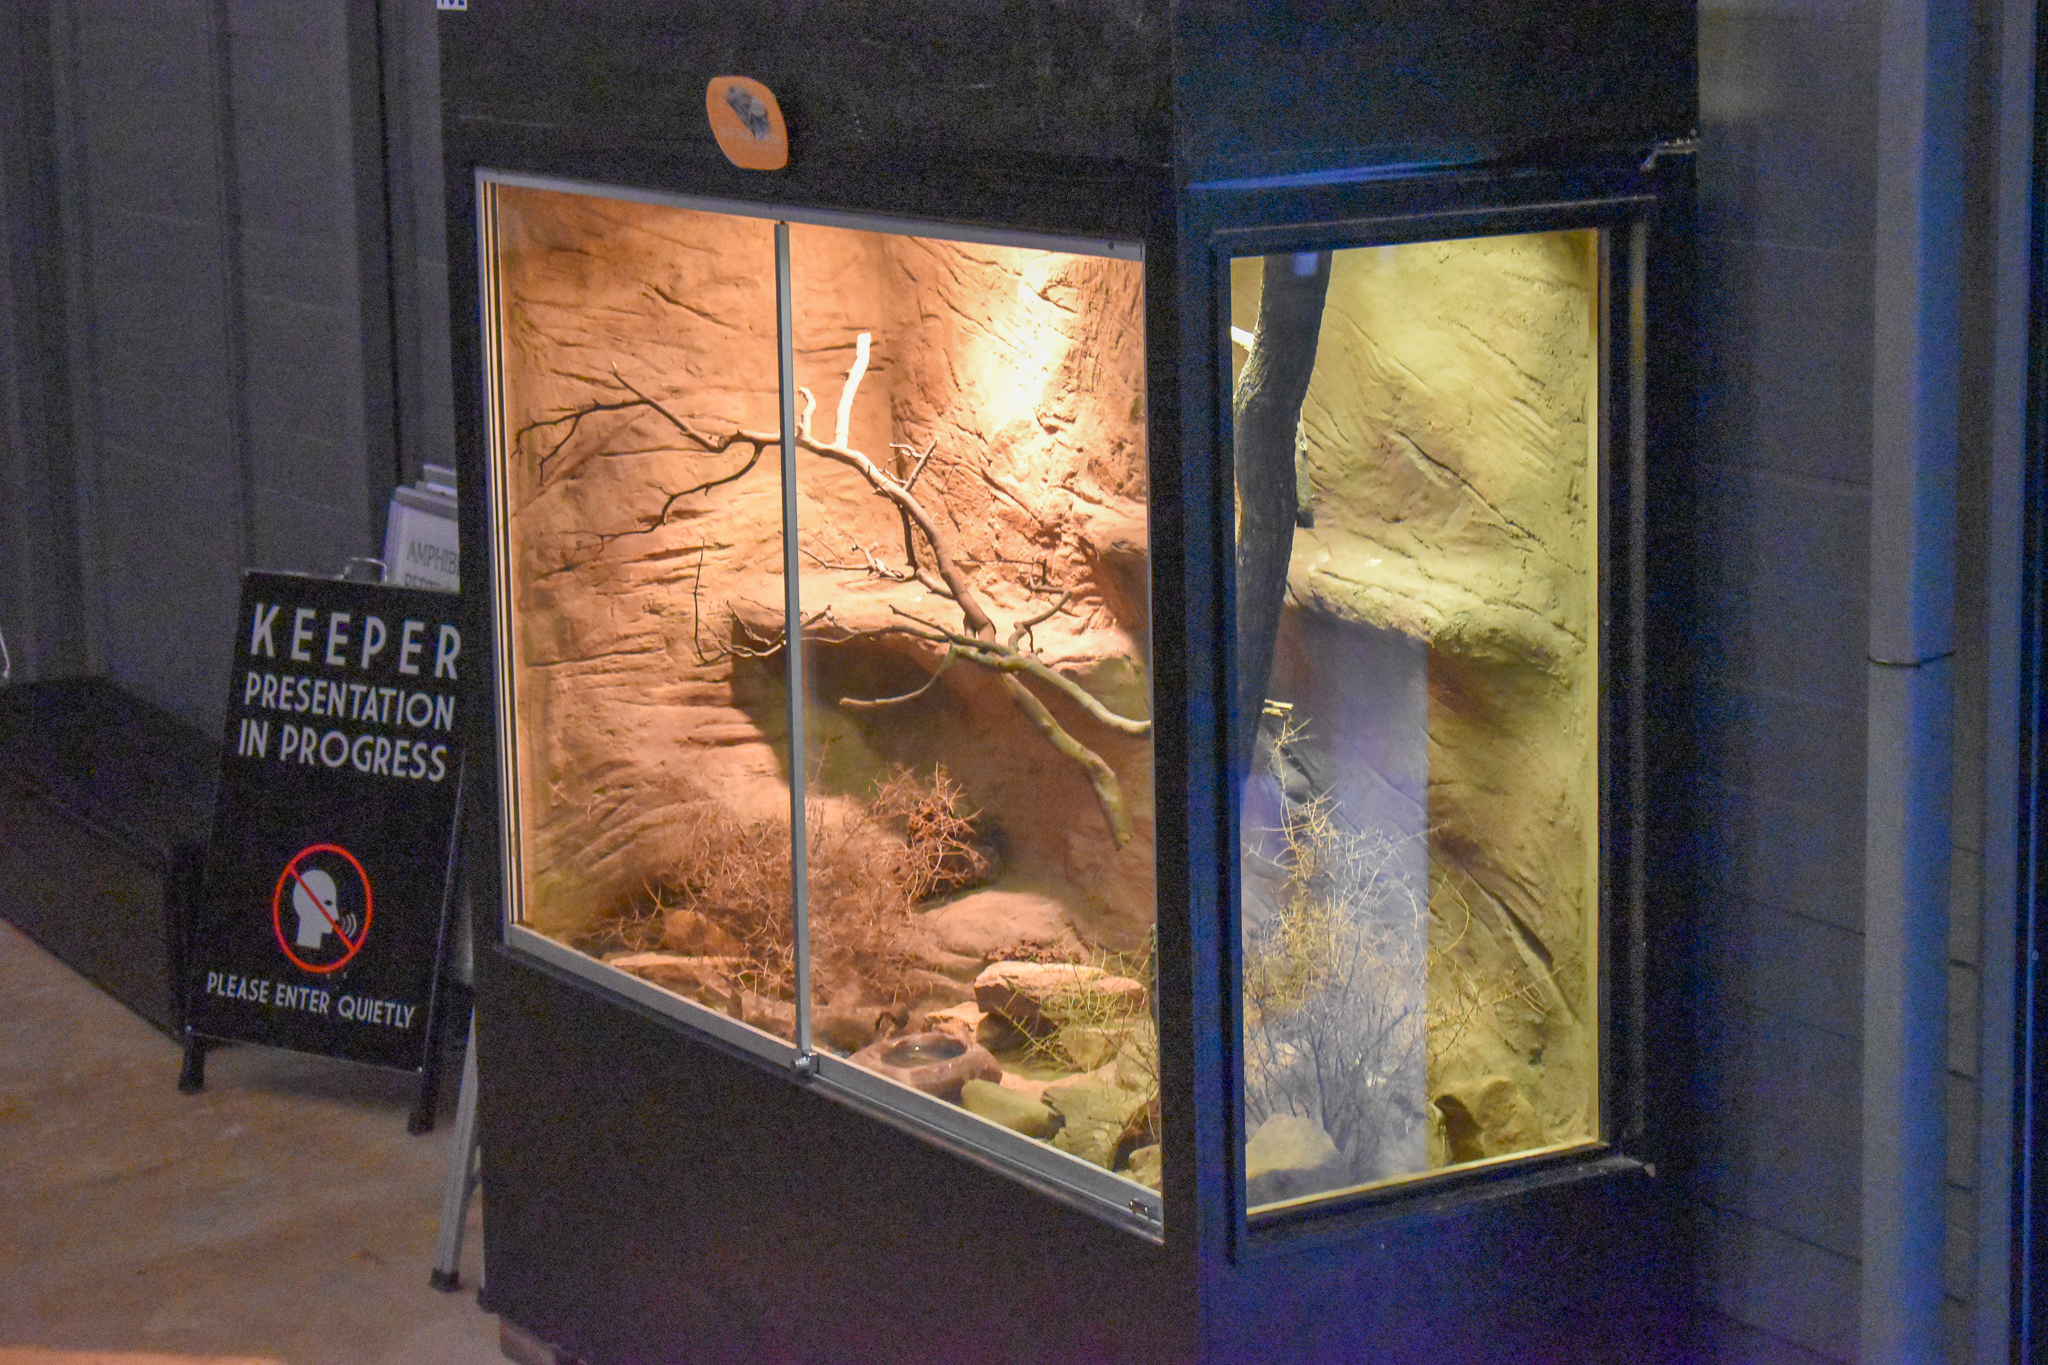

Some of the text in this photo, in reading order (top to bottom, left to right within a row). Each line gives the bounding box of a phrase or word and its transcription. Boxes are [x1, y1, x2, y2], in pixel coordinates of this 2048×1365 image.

[407, 541, 459, 576] AMPHIB
[250, 602, 462, 680] KEEPER
[244, 671, 455, 732] PRESENTATION
[238, 718, 447, 783] IN PROGRESS
[207, 971, 416, 1028] PLEASE ENTER QUIETLY
